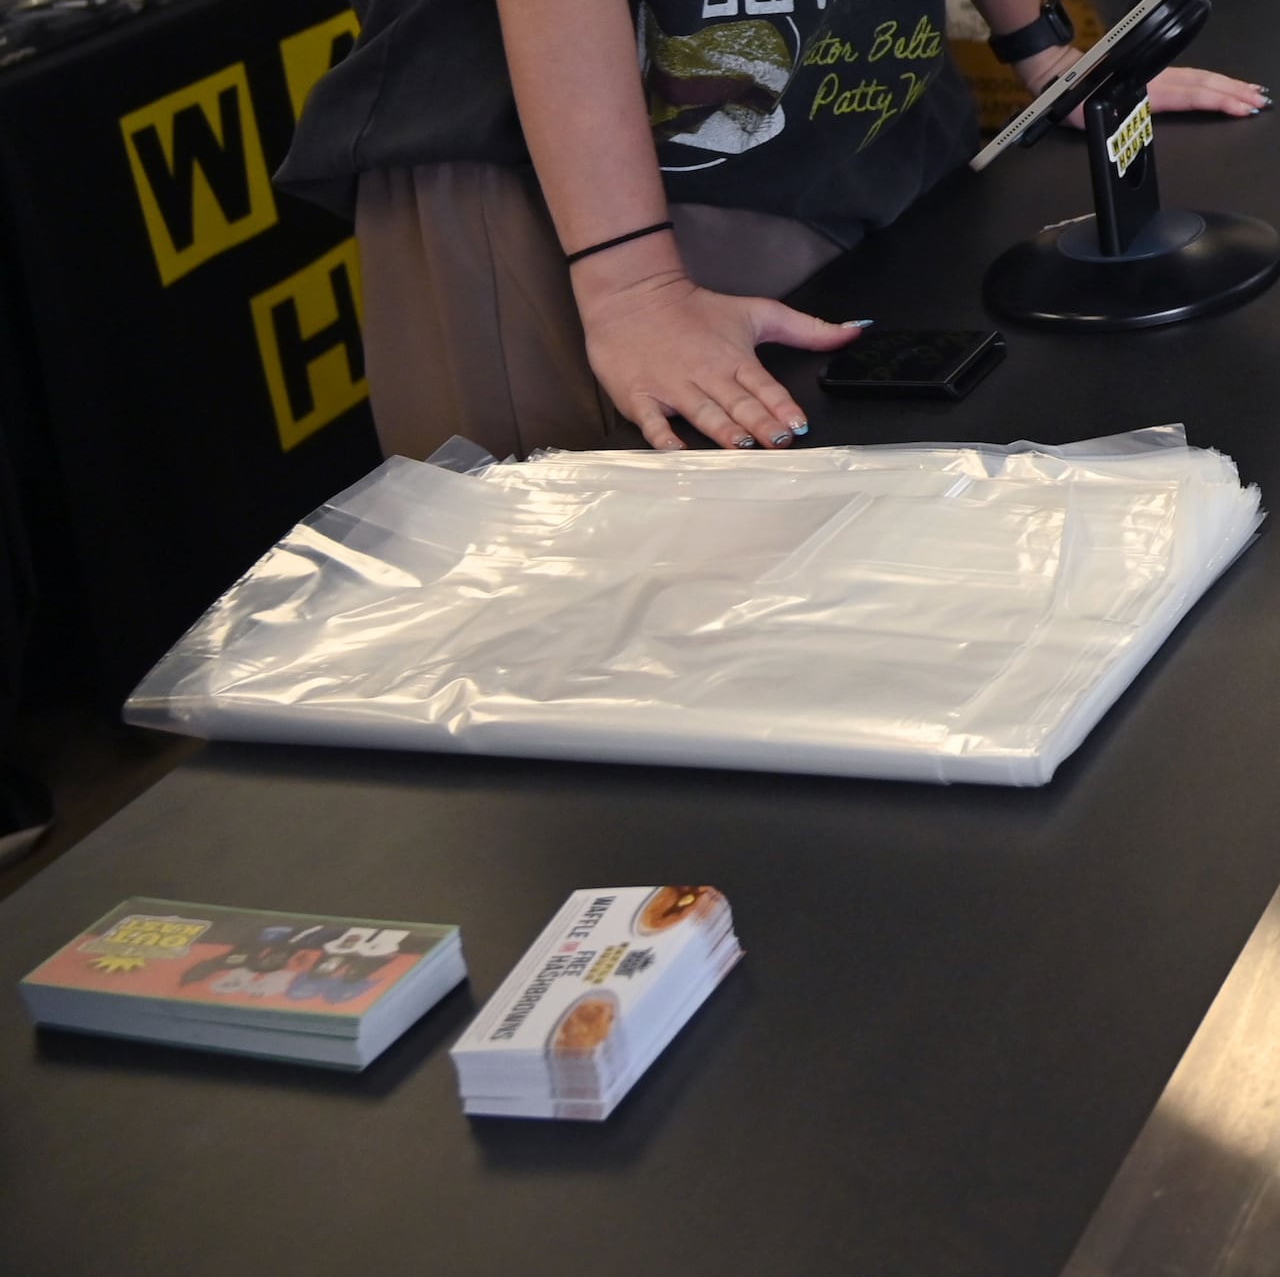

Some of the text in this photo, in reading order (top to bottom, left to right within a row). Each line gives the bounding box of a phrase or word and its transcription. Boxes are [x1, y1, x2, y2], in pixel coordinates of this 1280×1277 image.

[809, 73, 898, 154] Patty
[1112, 102, 1151, 155] WAFFLE
[1119, 123, 1150, 169] HOUSE
[567, 895, 617, 939] WAFFLE
[566, 950, 597, 978] FREE
[489, 954, 571, 1042] HASHBROWNS
